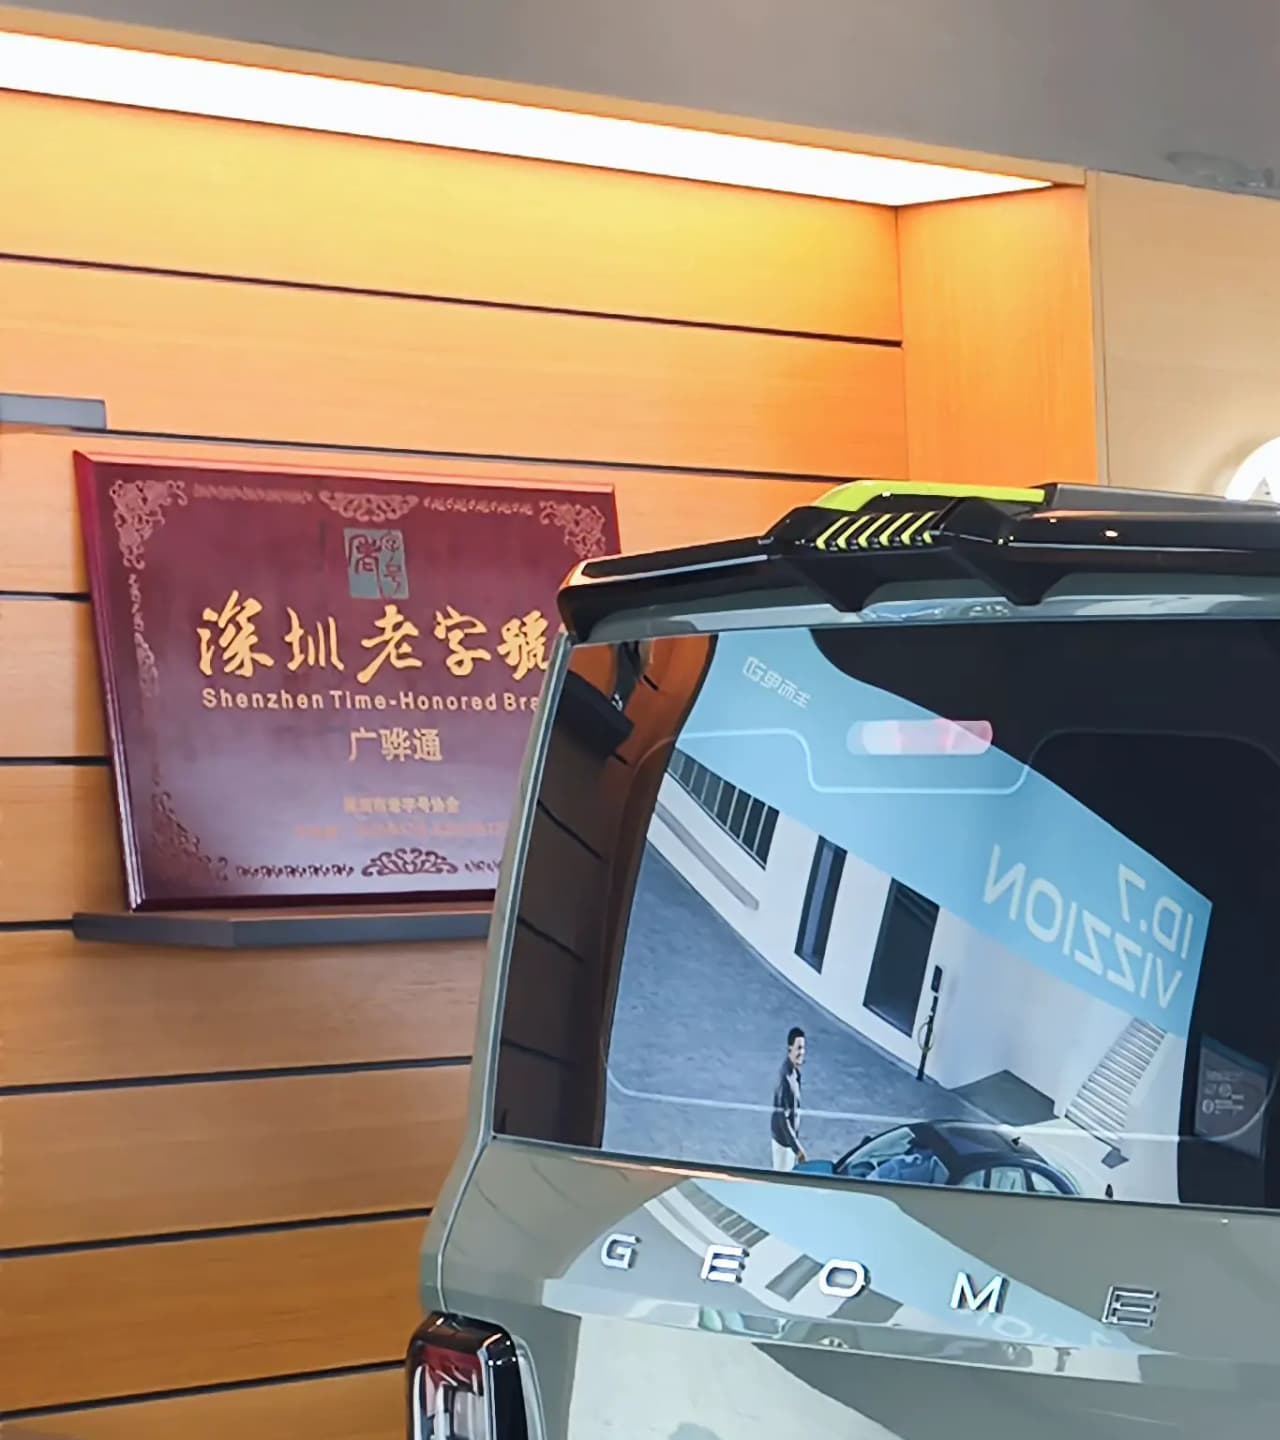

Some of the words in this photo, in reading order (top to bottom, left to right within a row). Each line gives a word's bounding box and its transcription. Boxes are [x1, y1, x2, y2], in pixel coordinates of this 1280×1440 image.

[202, 688, 324, 711] Shenzhen
[329, 690, 497, 712] Time-Honored
[503, 692, 540, 712] Bra
[349, 727, 443, 762] 广骅通
[600, 1232, 1160, 1328] GEOME
